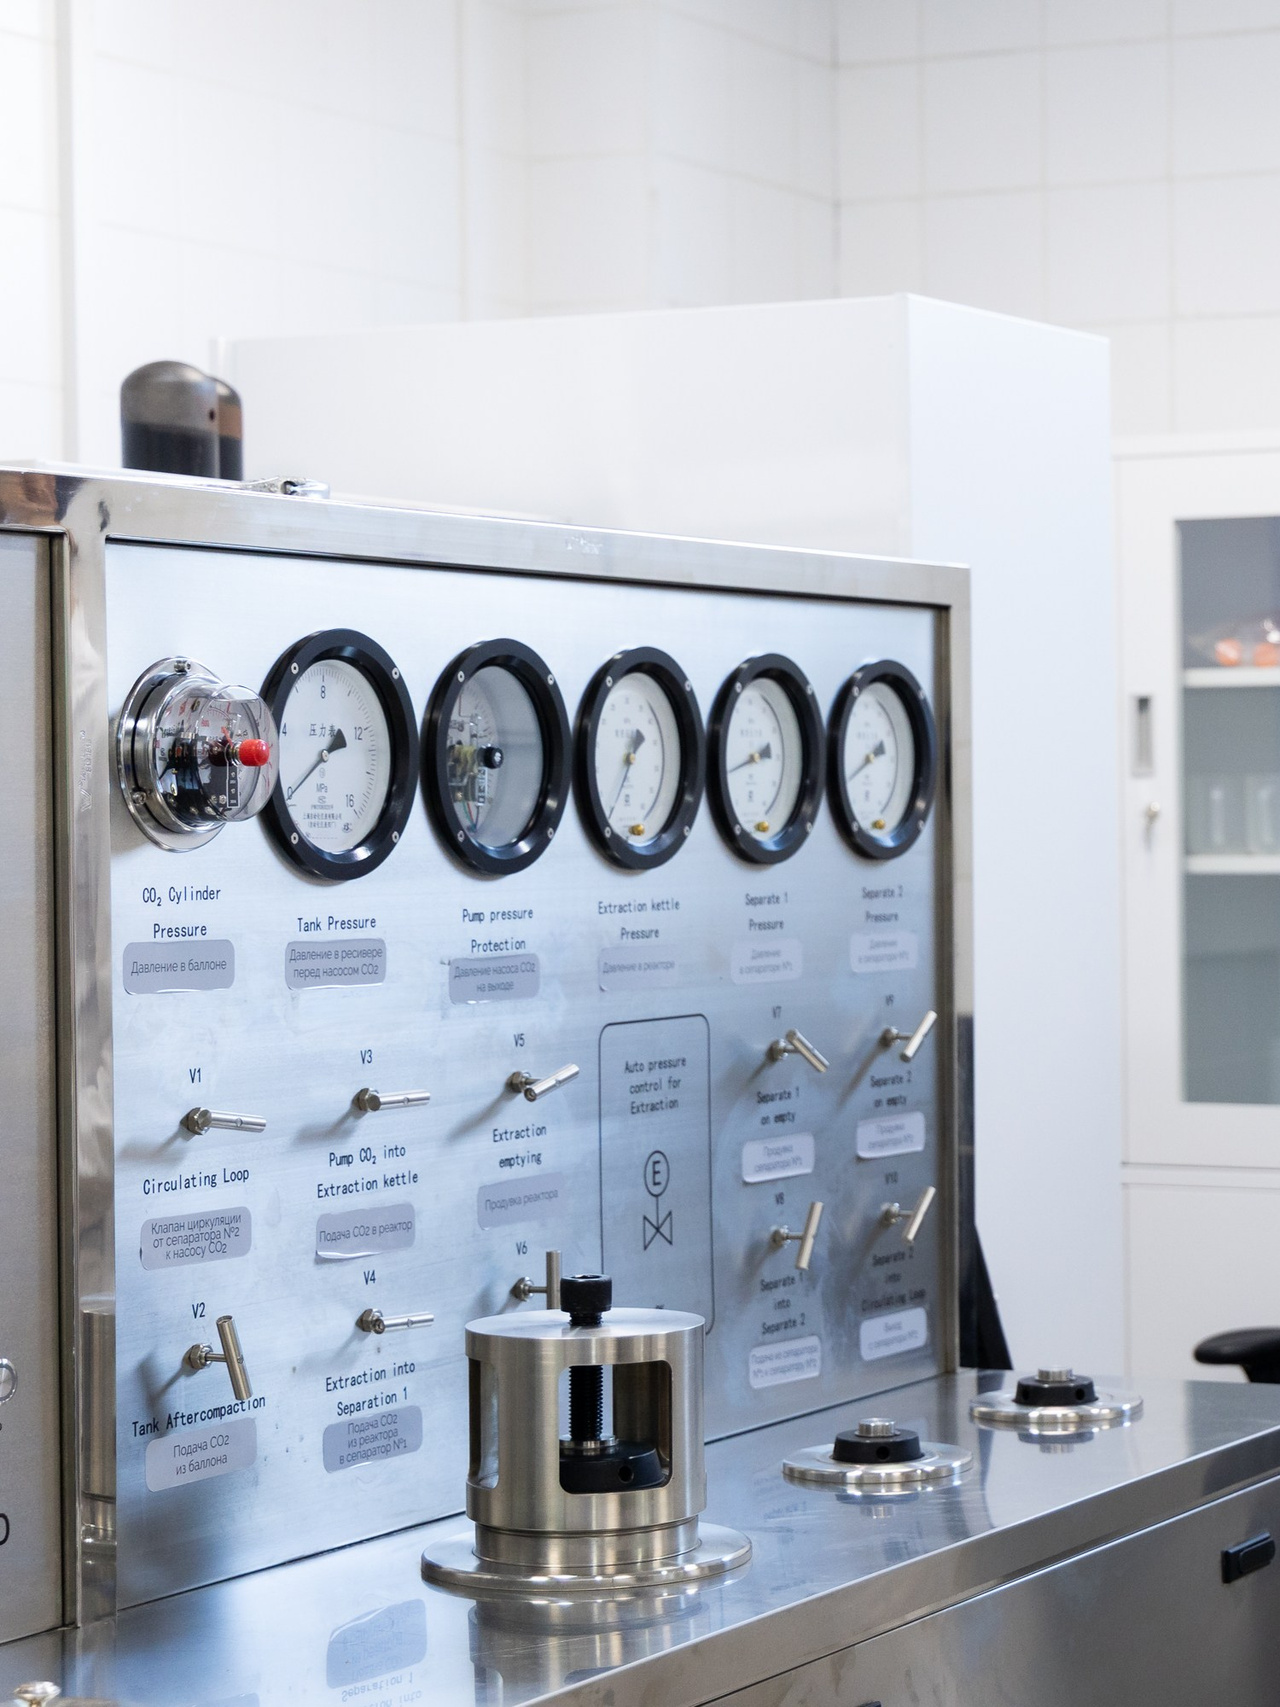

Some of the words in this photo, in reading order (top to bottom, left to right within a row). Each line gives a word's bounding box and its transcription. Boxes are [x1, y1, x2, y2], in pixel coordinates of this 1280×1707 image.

[320, 685, 326, 699] 8
[282, 723, 287, 737] 4
[309, 723, 336, 738] 压力表
[354, 726, 363, 741] 12
[316, 783, 328, 793] MPa
[345, 794, 355, 808] 16
[169, 886, 221, 904] Cylinder
[745, 893, 781, 907] Separate
[598, 901, 647, 915] Extraction
[651, 897, 680, 912] kettle
[297, 917, 322, 933] Tank
[328, 916, 376, 931] Pressure
[462, 909, 485, 924] Pump
[490, 908, 534, 922] pressure
[749, 918, 784, 931] Pressure
[865, 910, 898, 923] Pressure
[153, 923, 207, 939] Pressure
[620, 926, 659, 940] Pressure
[471, 938, 526, 953] Protection
[289, 948, 332, 963] Давление
[334, 950, 339, 960] в
[341, 947, 383, 963] ресивере
[131, 961, 179, 976] Давление
[181, 963, 186, 972] в
[188, 958, 227, 972] баллоне
[293, 967, 321, 980] перед
[323, 965, 359, 978] насосом
[454, 965, 491, 980] Давление
[492, 964, 519, 975] насоса
[476, 982, 488, 992] на
[513, 1033, 525, 1048] V5
[360, 1049, 373, 1064] V3
[624, 1059, 645, 1073] Auto
[647, 1055, 687, 1072] pressure
[189, 1068, 201, 1084] V1
[629, 1080, 663, 1094] control
[667, 1077, 681, 1090] for
[757, 1089, 793, 1105] Separate
[630, 1098, 679, 1115] Extraction
[492, 1124, 547, 1143] Extraction
[329, 1152, 353, 1167] Pump
[383, 1145, 406, 1159] into
[499, 1151, 542, 1169] emptying
[143, 1172, 217, 1195] Circulating
[223, 1168, 250, 1185] Loop
[652, 1161, 662, 1186] E
[317, 1179, 378, 1199] Extraction
[383, 1171, 419, 1189] kettle
[484, 1195, 522, 1212] Продувка
[151, 1221, 185, 1236] Клапан
[187, 1213, 242, 1232] циркуляции
[319, 1228, 350, 1243] Подача
[372, 1226, 377, 1235] в
[378, 1220, 413, 1238] реактор
[153, 1238, 164, 1249] от
[165, 1231, 221, 1248] сепаратора
[223, 1227, 240, 1240] №2
[165, 1250, 171, 1261] к
[173, 1245, 206, 1260] насосу
[516, 1241, 528, 1256] V6
[363, 1270, 376, 1285] V4
[760, 1275, 796, 1292] Separate
[192, 1302, 206, 1319] V2
[774, 1297, 791, 1310] into
[762, 1318, 798, 1336] Separate
[325, 1368, 386, 1392] Extraction
[393, 1361, 416, 1377] into
[337, 1392, 398, 1417] Separation
[403, 1386, 408, 1401] 1
[132, 1417, 160, 1438] Tank
[166, 1394, 266, 1430] Aftercompaction
[347, 1417, 378, 1435] Подача
[347, 1438, 357, 1448] из
[359, 1427, 399, 1448] реактора
[173, 1439, 208, 1458] Подача
[339, 1454, 345, 1465] в
[346, 1441, 392, 1464] сепаратор
[175, 1465, 186, 1476] из
[188, 1453, 228, 1473] баллона
